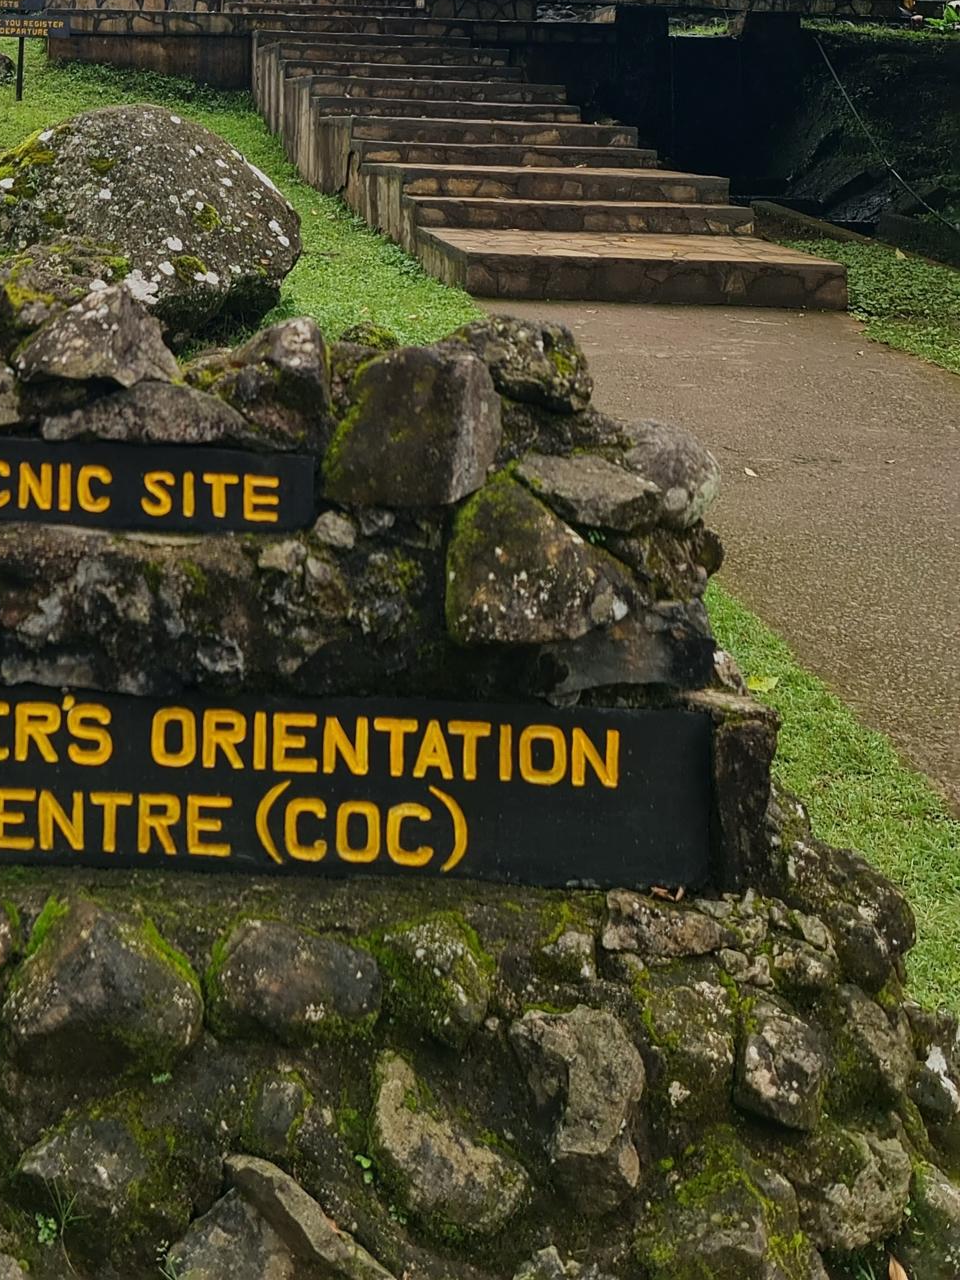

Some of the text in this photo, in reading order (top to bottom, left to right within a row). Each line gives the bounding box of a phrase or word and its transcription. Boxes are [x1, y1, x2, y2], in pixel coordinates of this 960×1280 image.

[0, 27, 49, 36] DEPARTURE
[23, 20, 64, 28] REGISTER
[140, 469, 280, 524] SITE
[150, 706, 622, 790] ORIENTATION
[254, 779, 470, 873] (COC)
